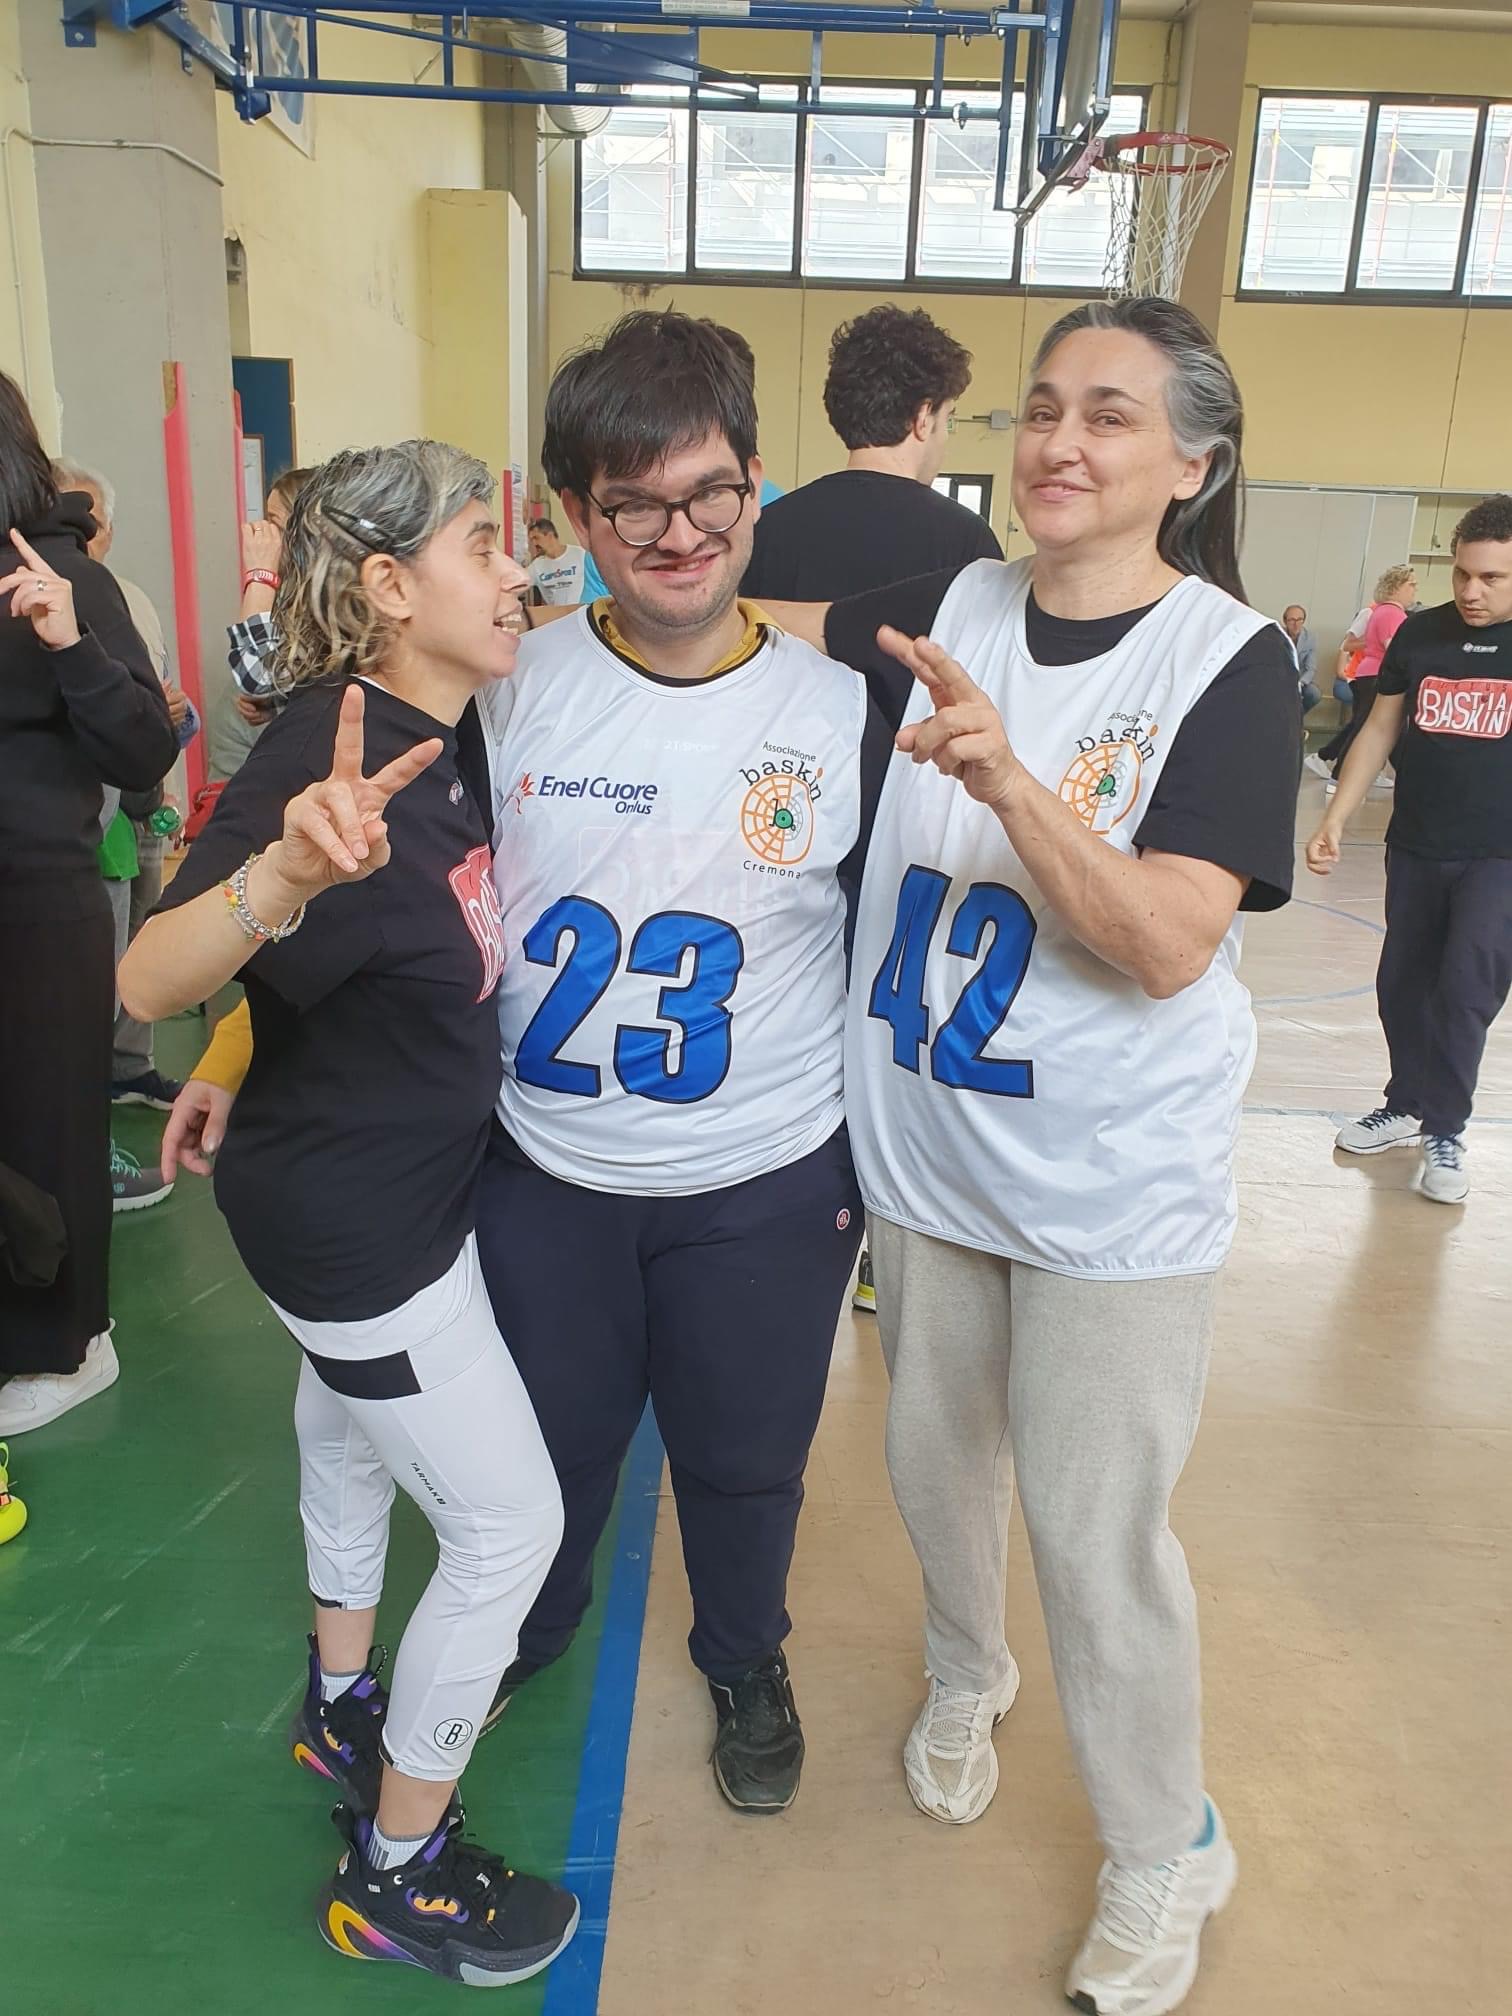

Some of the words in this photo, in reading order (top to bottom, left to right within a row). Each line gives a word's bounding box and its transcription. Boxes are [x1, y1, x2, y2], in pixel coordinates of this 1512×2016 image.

[762, 741, 817, 762] Associazione
[538, 775, 588, 798] Enel
[589, 777, 658, 801] Cuore
[738, 759, 823, 803] baskin
[615, 801, 653, 815] Onlus
[743, 860, 801, 880] Cremona
[868, 863, 1038, 1099] 42
[513, 895, 745, 1105] 23
[444, 1723, 463, 1745] B
